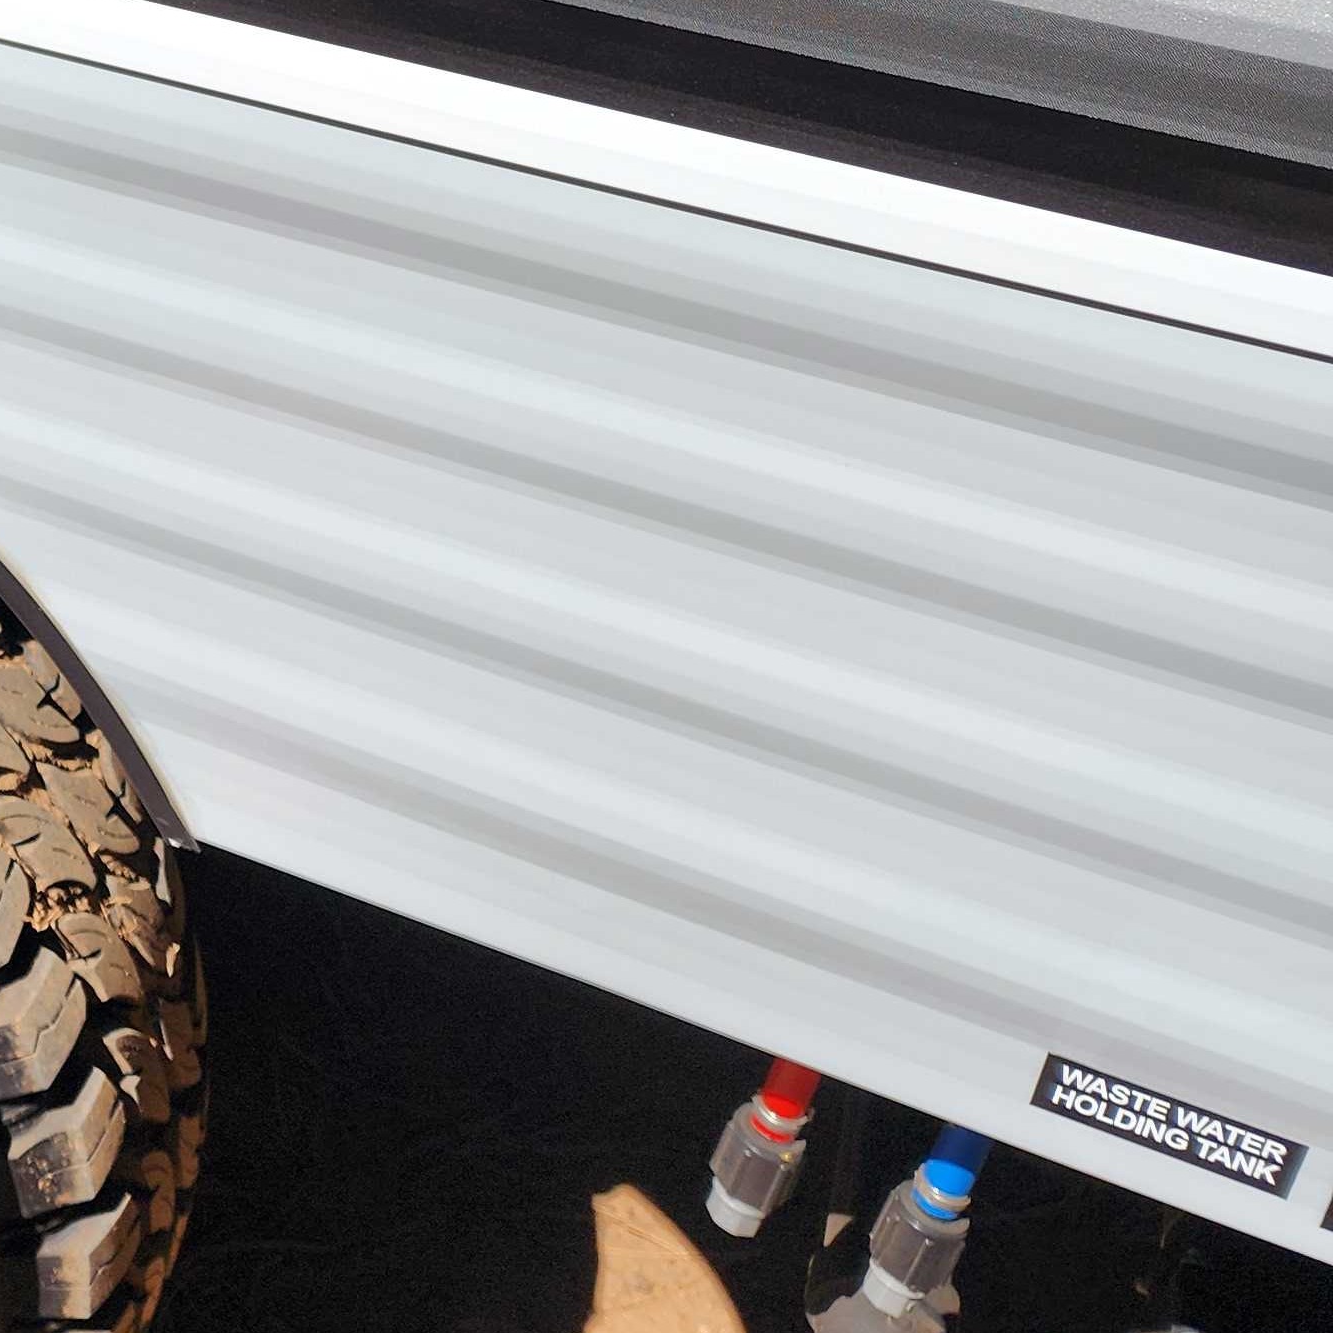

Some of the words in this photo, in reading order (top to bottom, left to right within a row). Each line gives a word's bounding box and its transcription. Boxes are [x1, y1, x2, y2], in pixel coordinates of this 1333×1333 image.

[1051, 1084, 1190, 1151] HOLDING
[1196, 1136, 1282, 1186] TANK
[1061, 1064, 1170, 1122] WASTE
[1176, 1105, 1288, 1165] WATER
